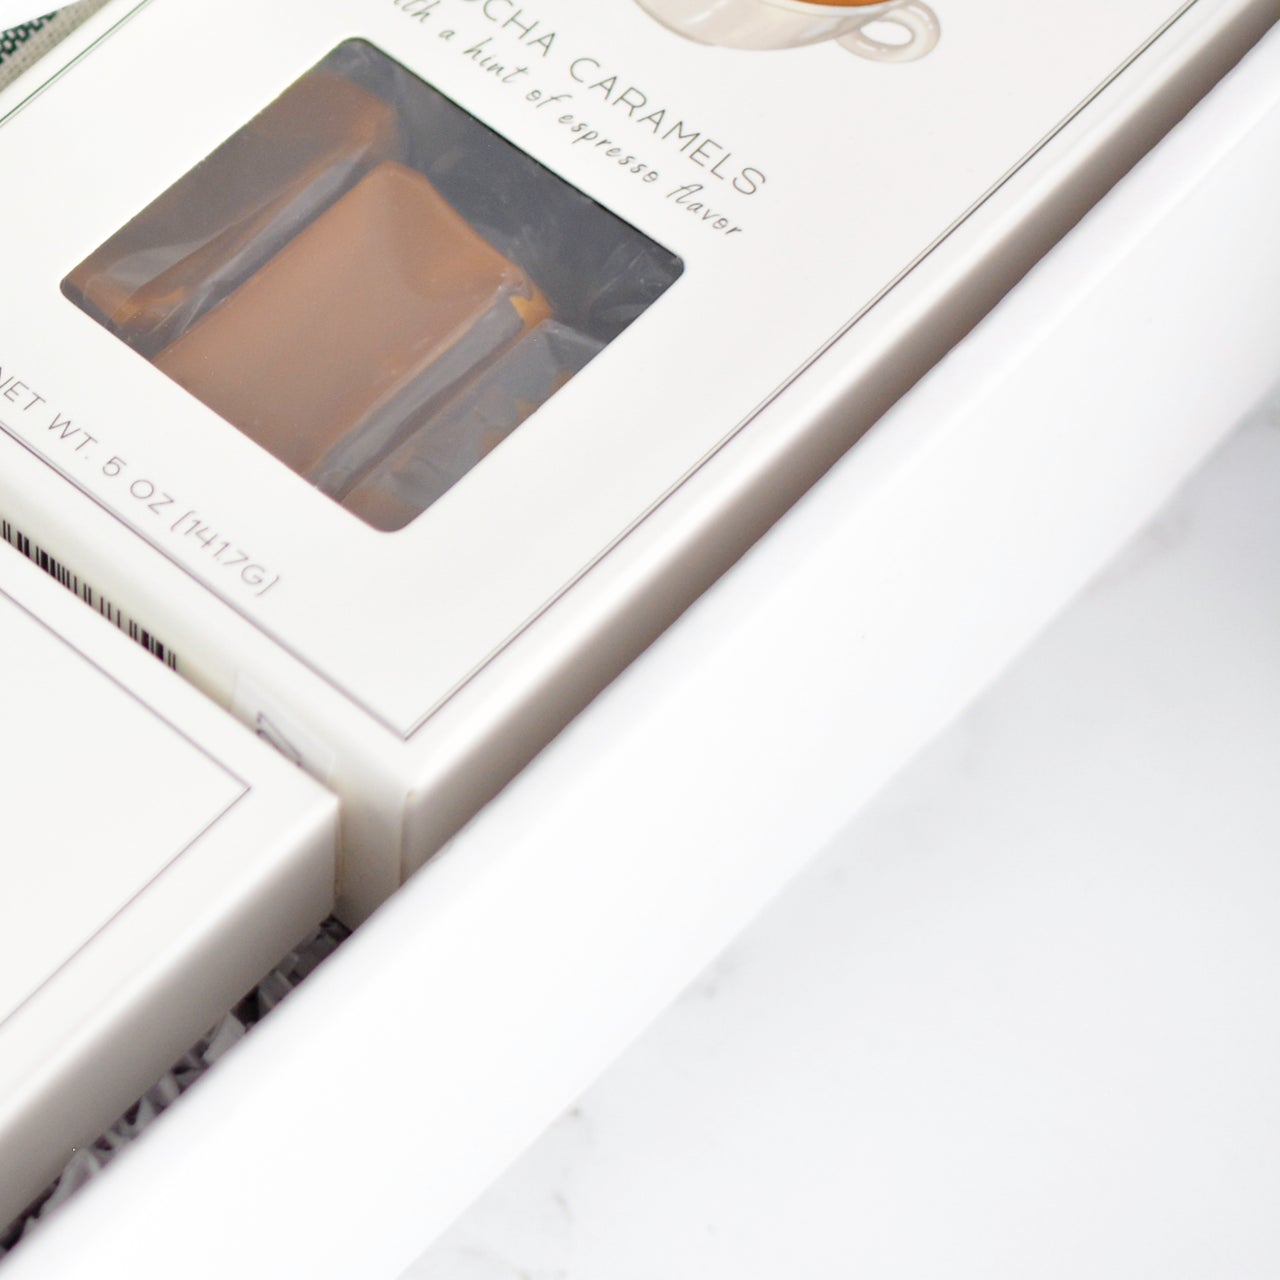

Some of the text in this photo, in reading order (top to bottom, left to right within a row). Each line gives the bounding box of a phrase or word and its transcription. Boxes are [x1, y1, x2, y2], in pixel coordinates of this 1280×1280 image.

[438, 29, 455, 41] a
[463, 37, 529, 83] hint
[525, 89, 573, 109] of
[558, 115, 660, 183] espresso
[666, 183, 743, 236] flavor
[570, 57, 767, 197] CARAMELS
[48, 412, 98, 460] WT.
[102, 455, 127, 477] 5
[130, 479, 175, 515] OZ
